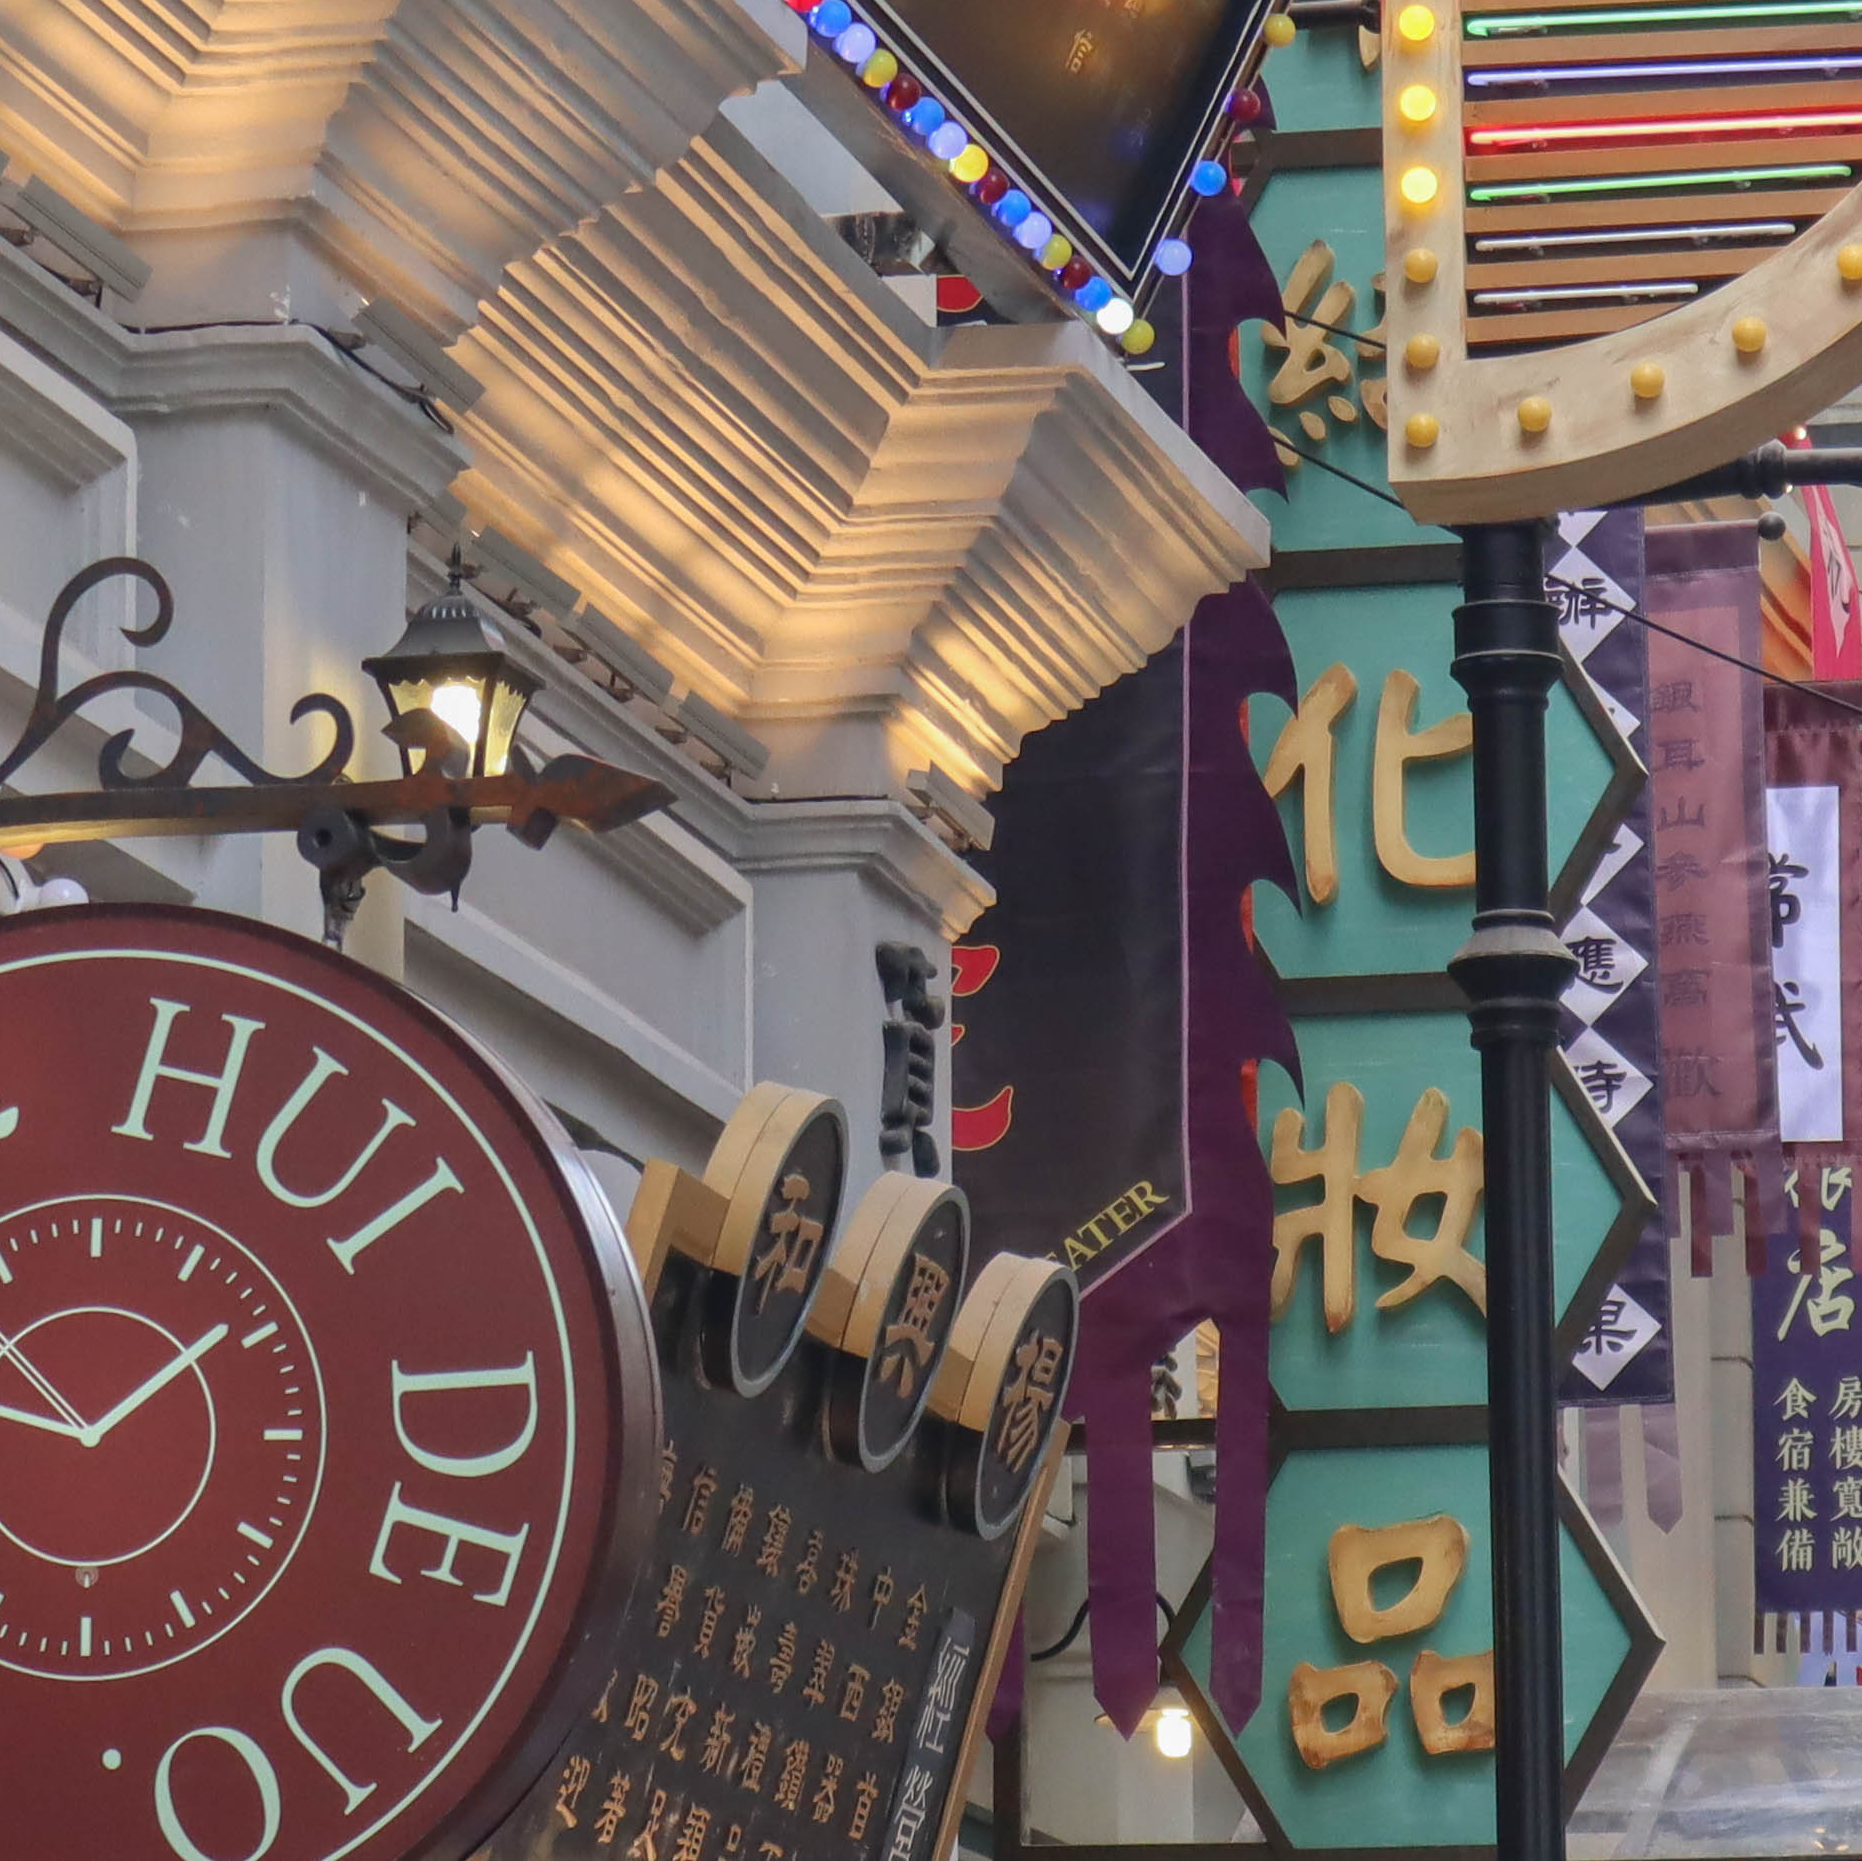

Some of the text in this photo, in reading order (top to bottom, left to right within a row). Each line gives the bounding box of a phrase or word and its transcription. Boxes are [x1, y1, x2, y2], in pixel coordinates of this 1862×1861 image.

[111, 997, 466, 1275] HUI
[370, 1350, 540, 1607] DE
[1774, 1376, 1818, 1573] 食宿兼備
